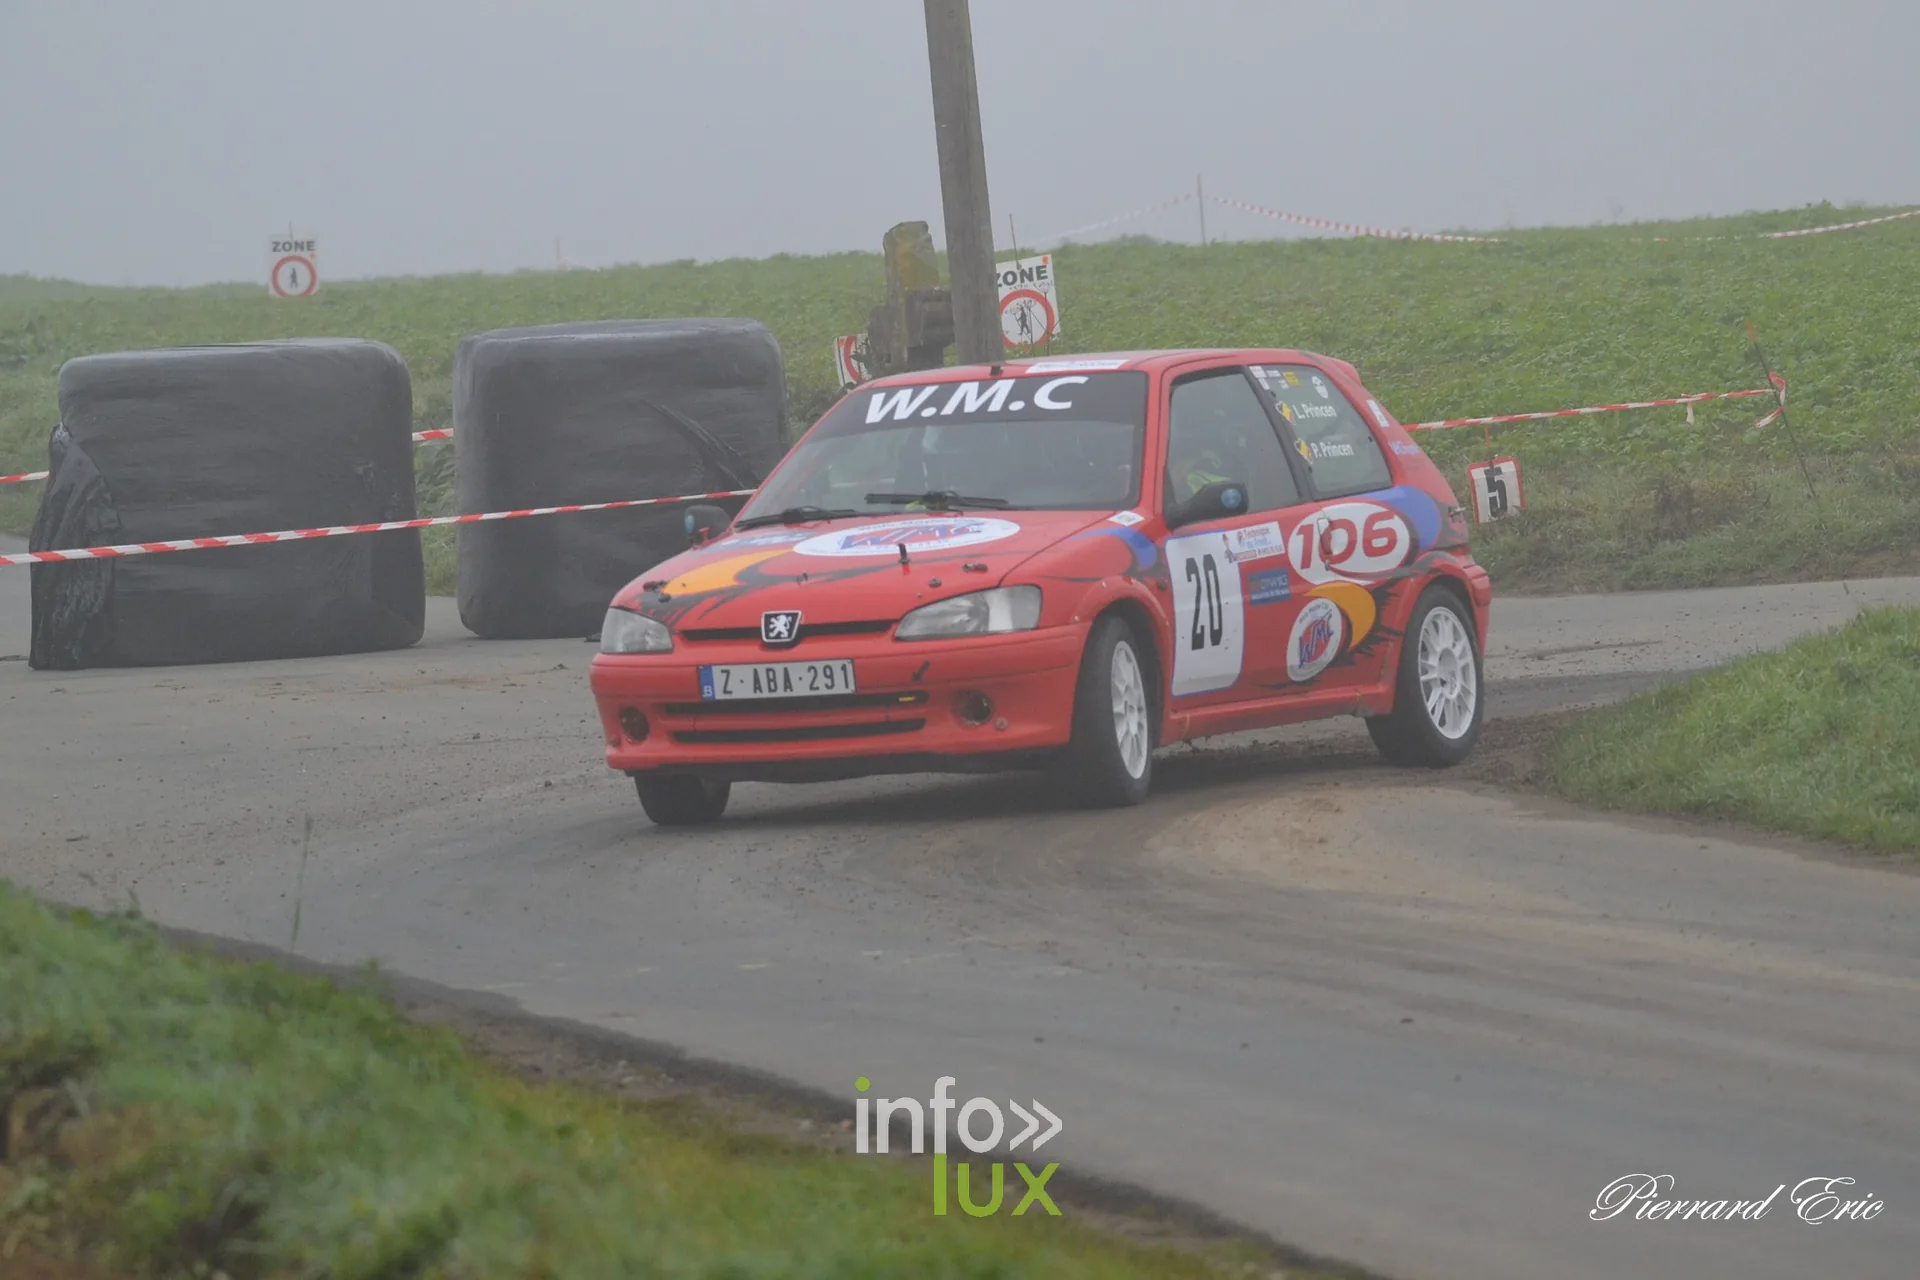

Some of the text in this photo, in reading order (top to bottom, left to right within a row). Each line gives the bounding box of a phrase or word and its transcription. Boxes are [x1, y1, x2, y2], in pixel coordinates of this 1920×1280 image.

[271, 240, 316, 252] ZONE
[1484, 466, 1508, 518] 5
[1296, 511, 1398, 570] 106
[1185, 553, 1223, 651] 20
